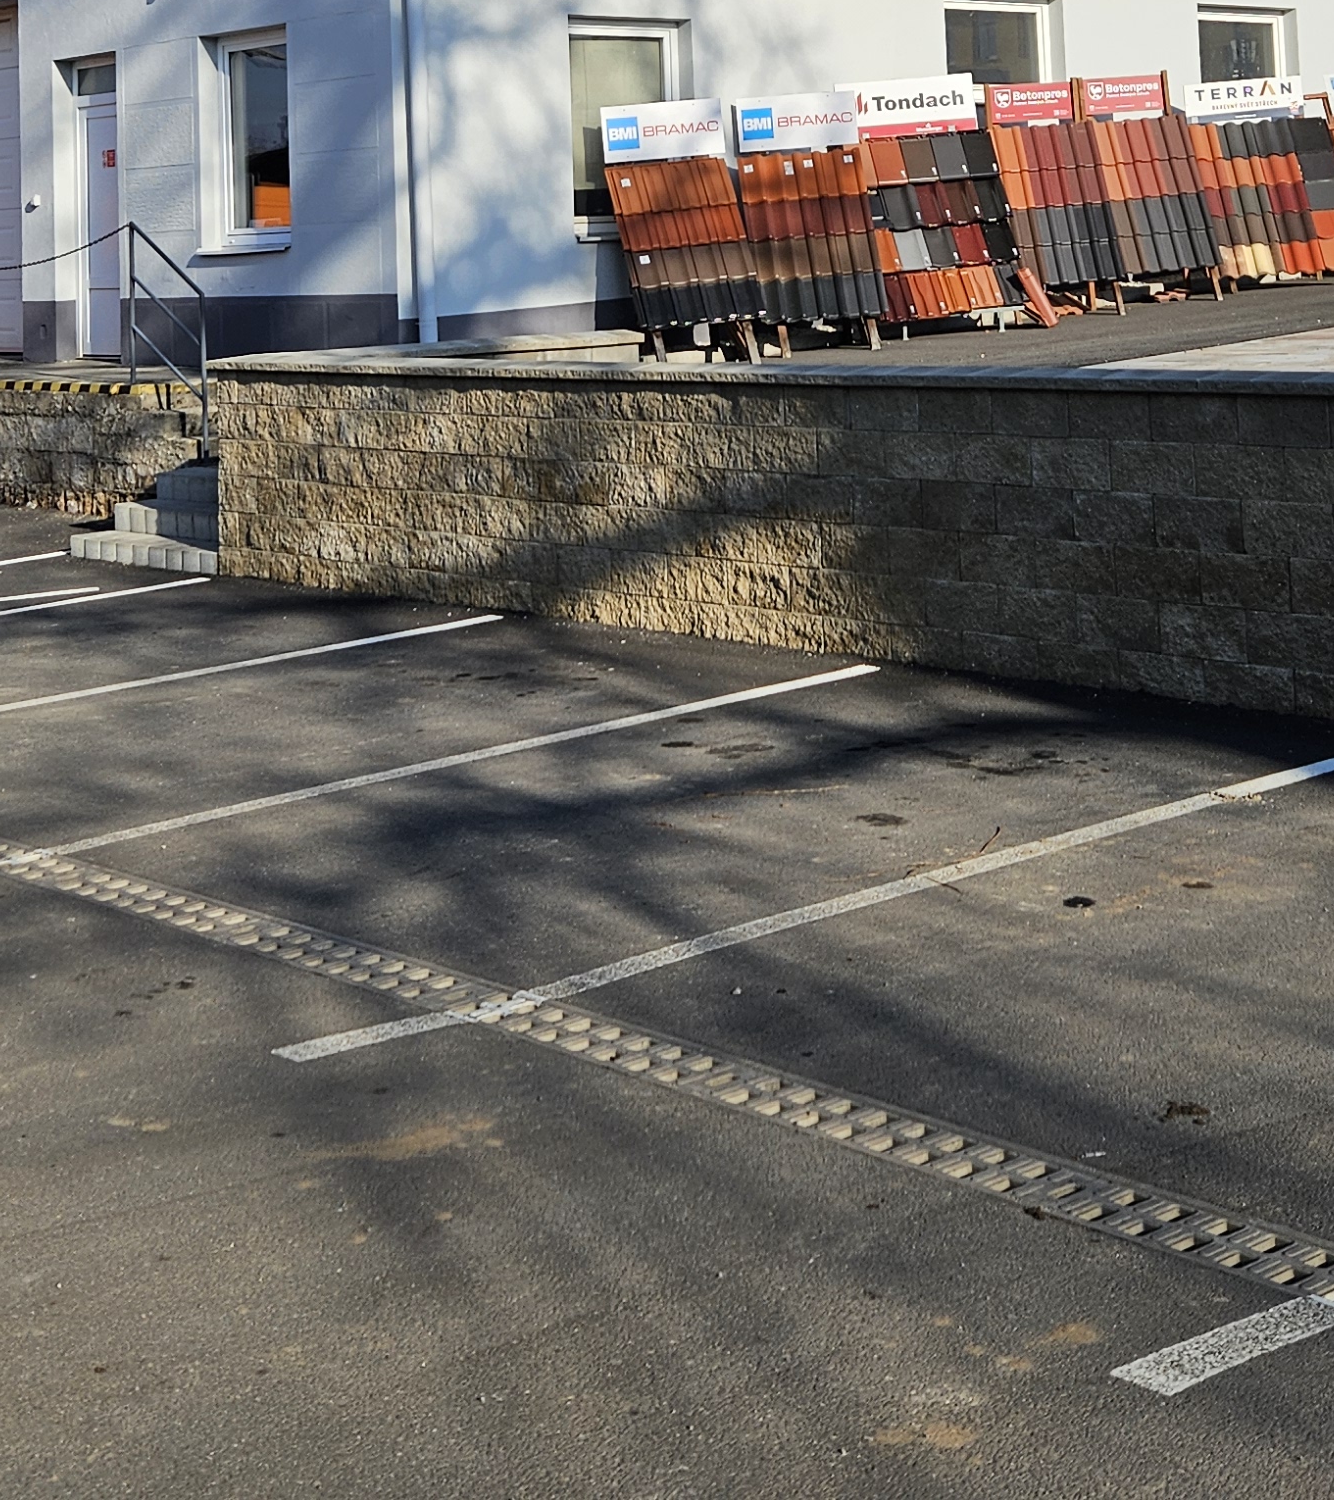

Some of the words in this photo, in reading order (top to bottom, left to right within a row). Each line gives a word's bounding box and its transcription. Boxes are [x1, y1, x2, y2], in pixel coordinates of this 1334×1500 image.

[871, 90, 965, 112] Tondach
[608, 127, 638, 141] BMI
[643, 120, 720, 137] BRAMAC
[743, 116, 772, 131] BMI
[777, 111, 854, 127] BRAMAC
